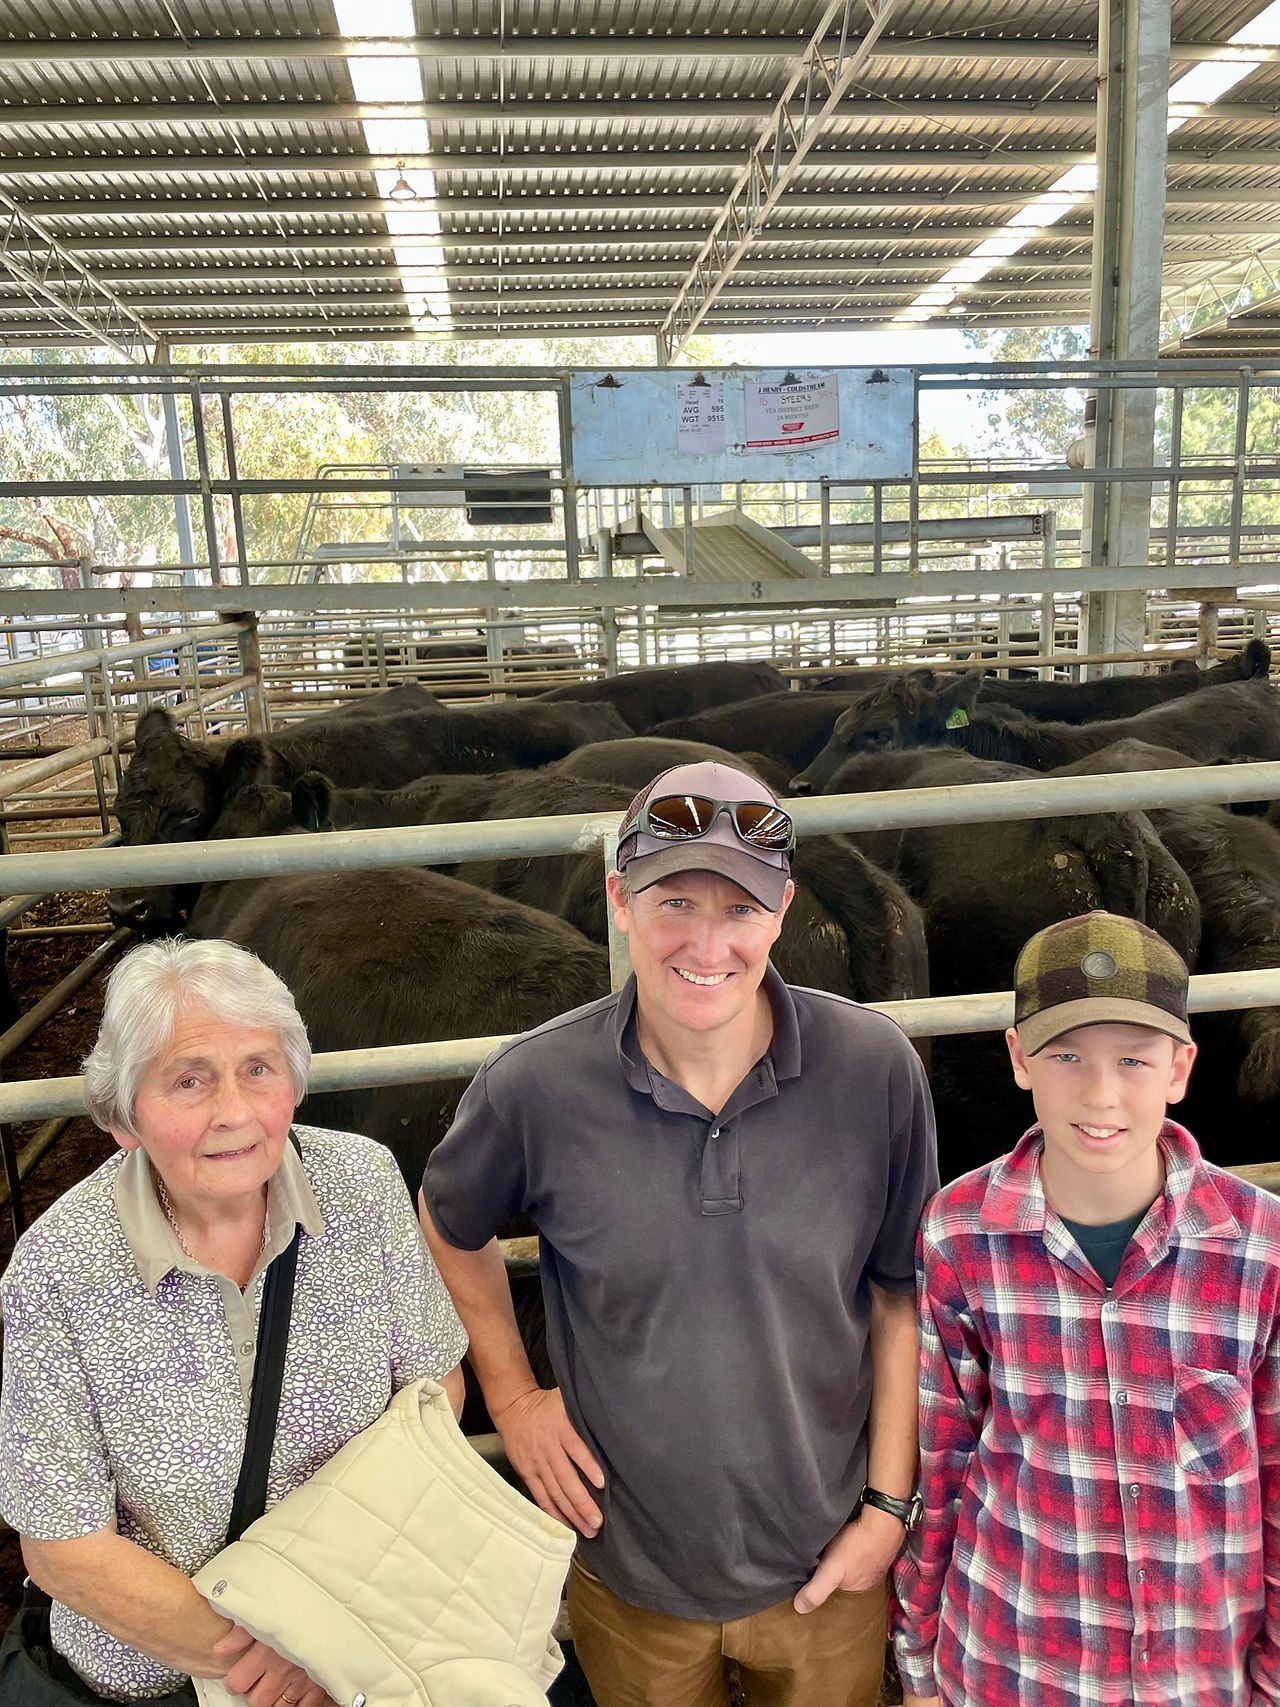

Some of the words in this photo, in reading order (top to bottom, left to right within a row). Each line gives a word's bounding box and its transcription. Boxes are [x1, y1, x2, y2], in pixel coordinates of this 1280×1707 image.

[786, 382, 825, 392] COLDSTREAM
[781, 394, 812, 405] STEERS
[777, 405, 803, 413] DISTRICT
[681, 415, 699, 423] WGT
[706, 414, 725, 422] 9515
[784, 412, 809, 420] MONTHS
[751, 580, 762, 600] 3
